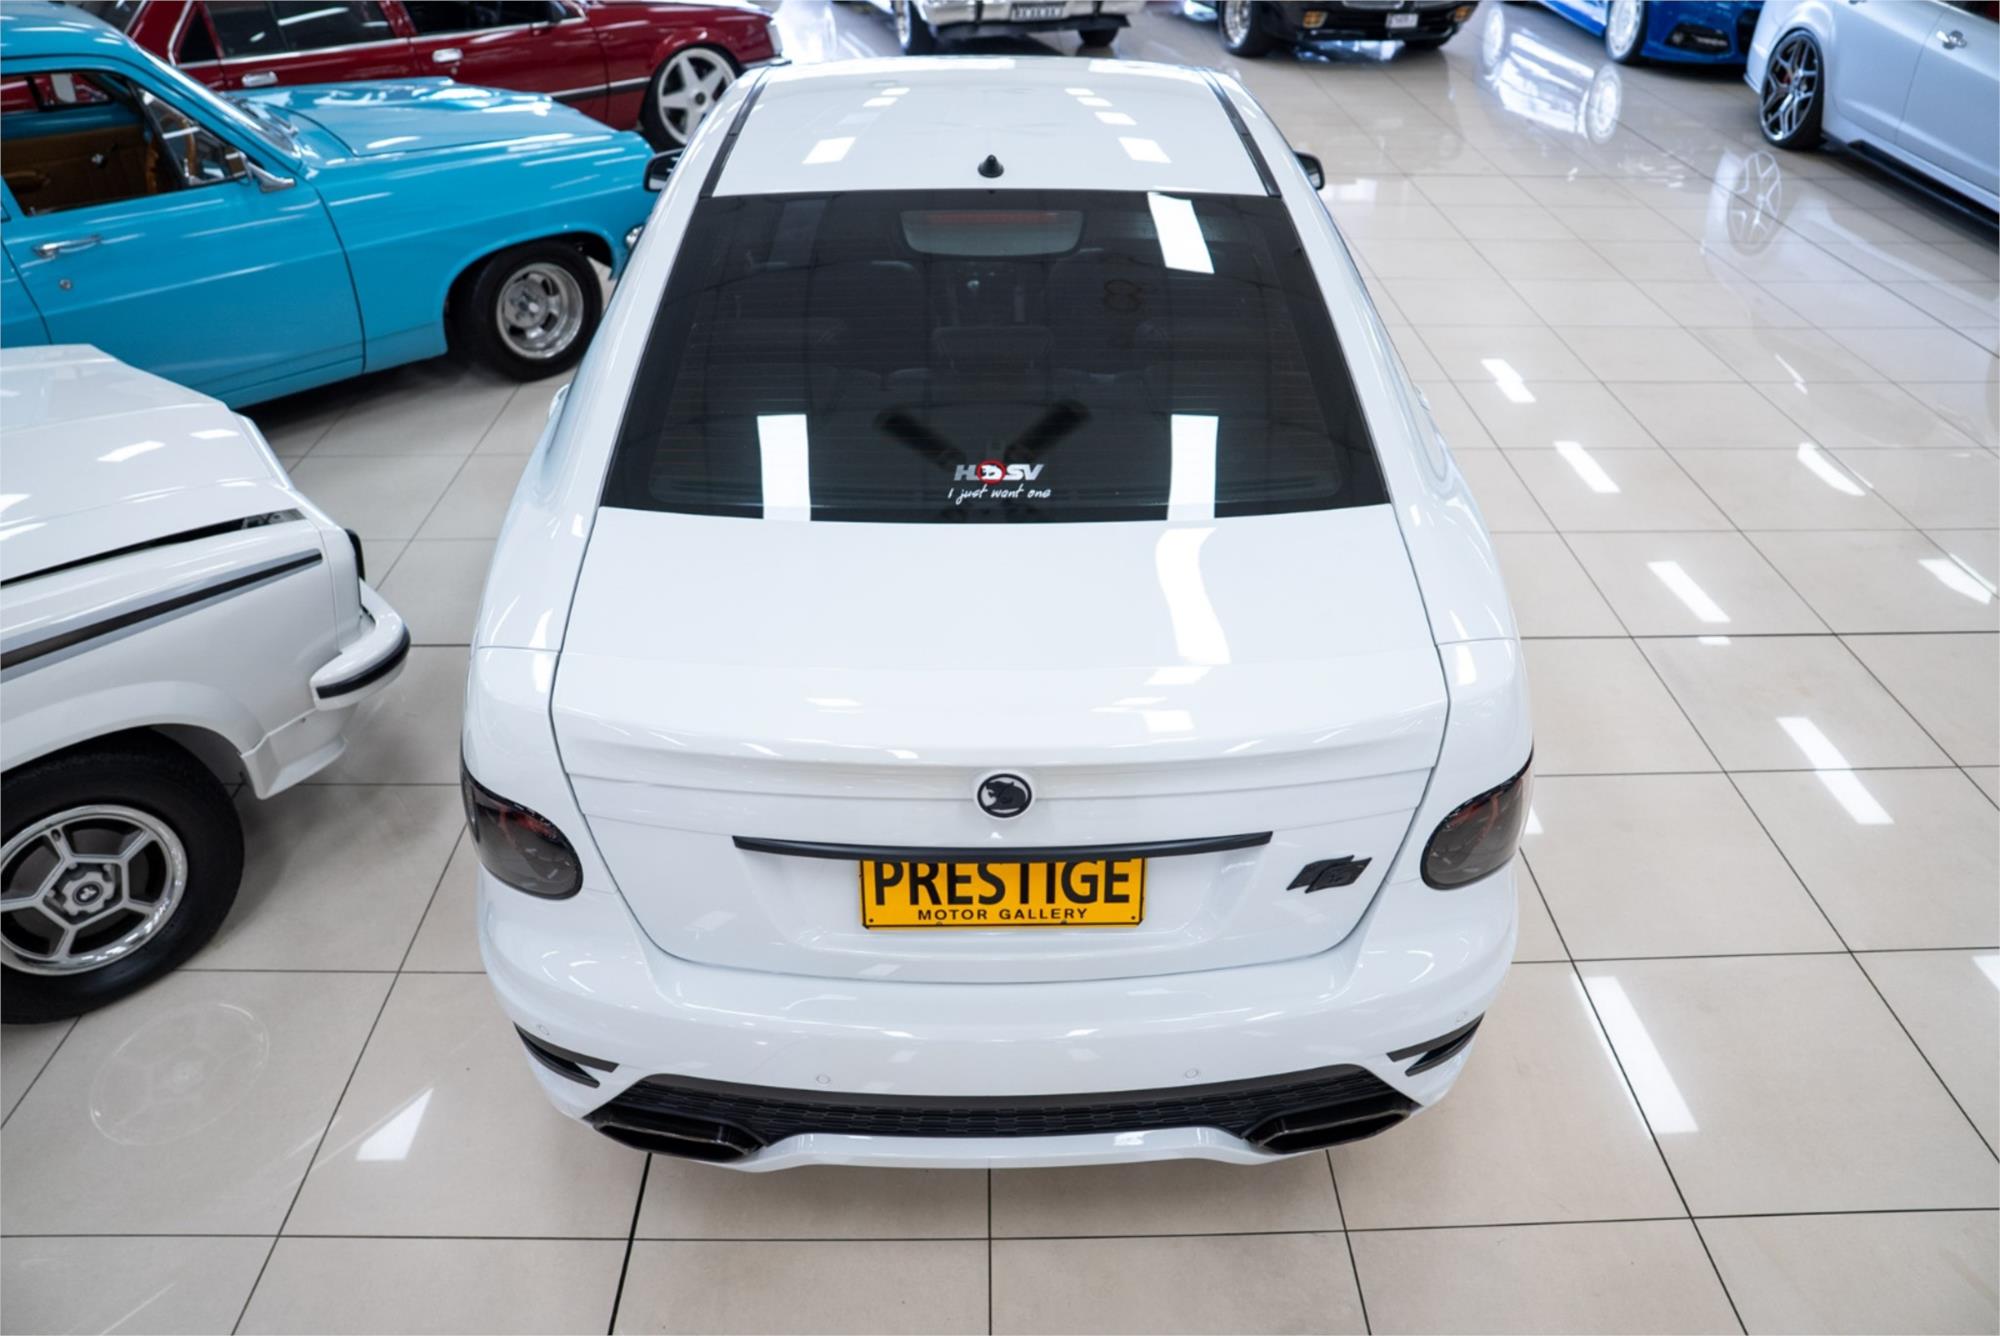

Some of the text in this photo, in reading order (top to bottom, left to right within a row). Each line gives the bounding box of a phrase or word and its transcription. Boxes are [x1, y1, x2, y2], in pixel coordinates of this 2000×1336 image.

[955, 483, 988, 505] just
[990, 483, 1024, 498] want
[1027, 488, 1052, 498] one
[917, 908, 1088, 921] MOTOR GALLERY
